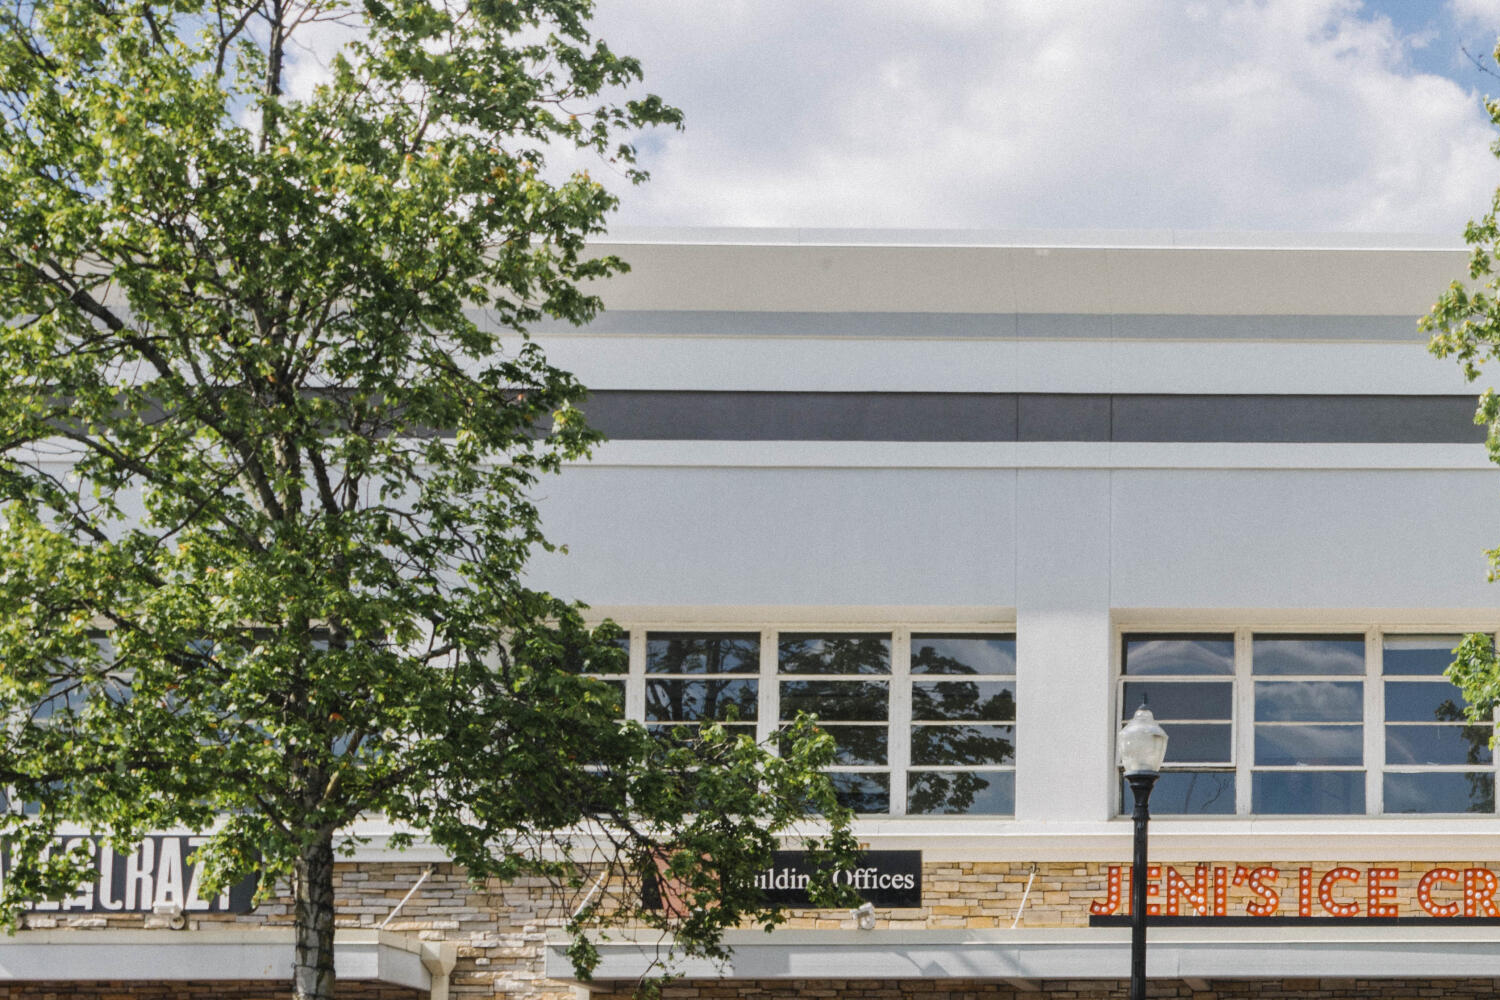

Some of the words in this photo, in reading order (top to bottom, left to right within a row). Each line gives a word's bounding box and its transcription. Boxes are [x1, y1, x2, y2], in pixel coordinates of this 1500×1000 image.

[100, 836, 231, 911] CRAZ
[832, 868, 915, 890] Offices
[1089, 866, 1280, 917] JENI'S
[1300, 867, 1398, 917] ICE
